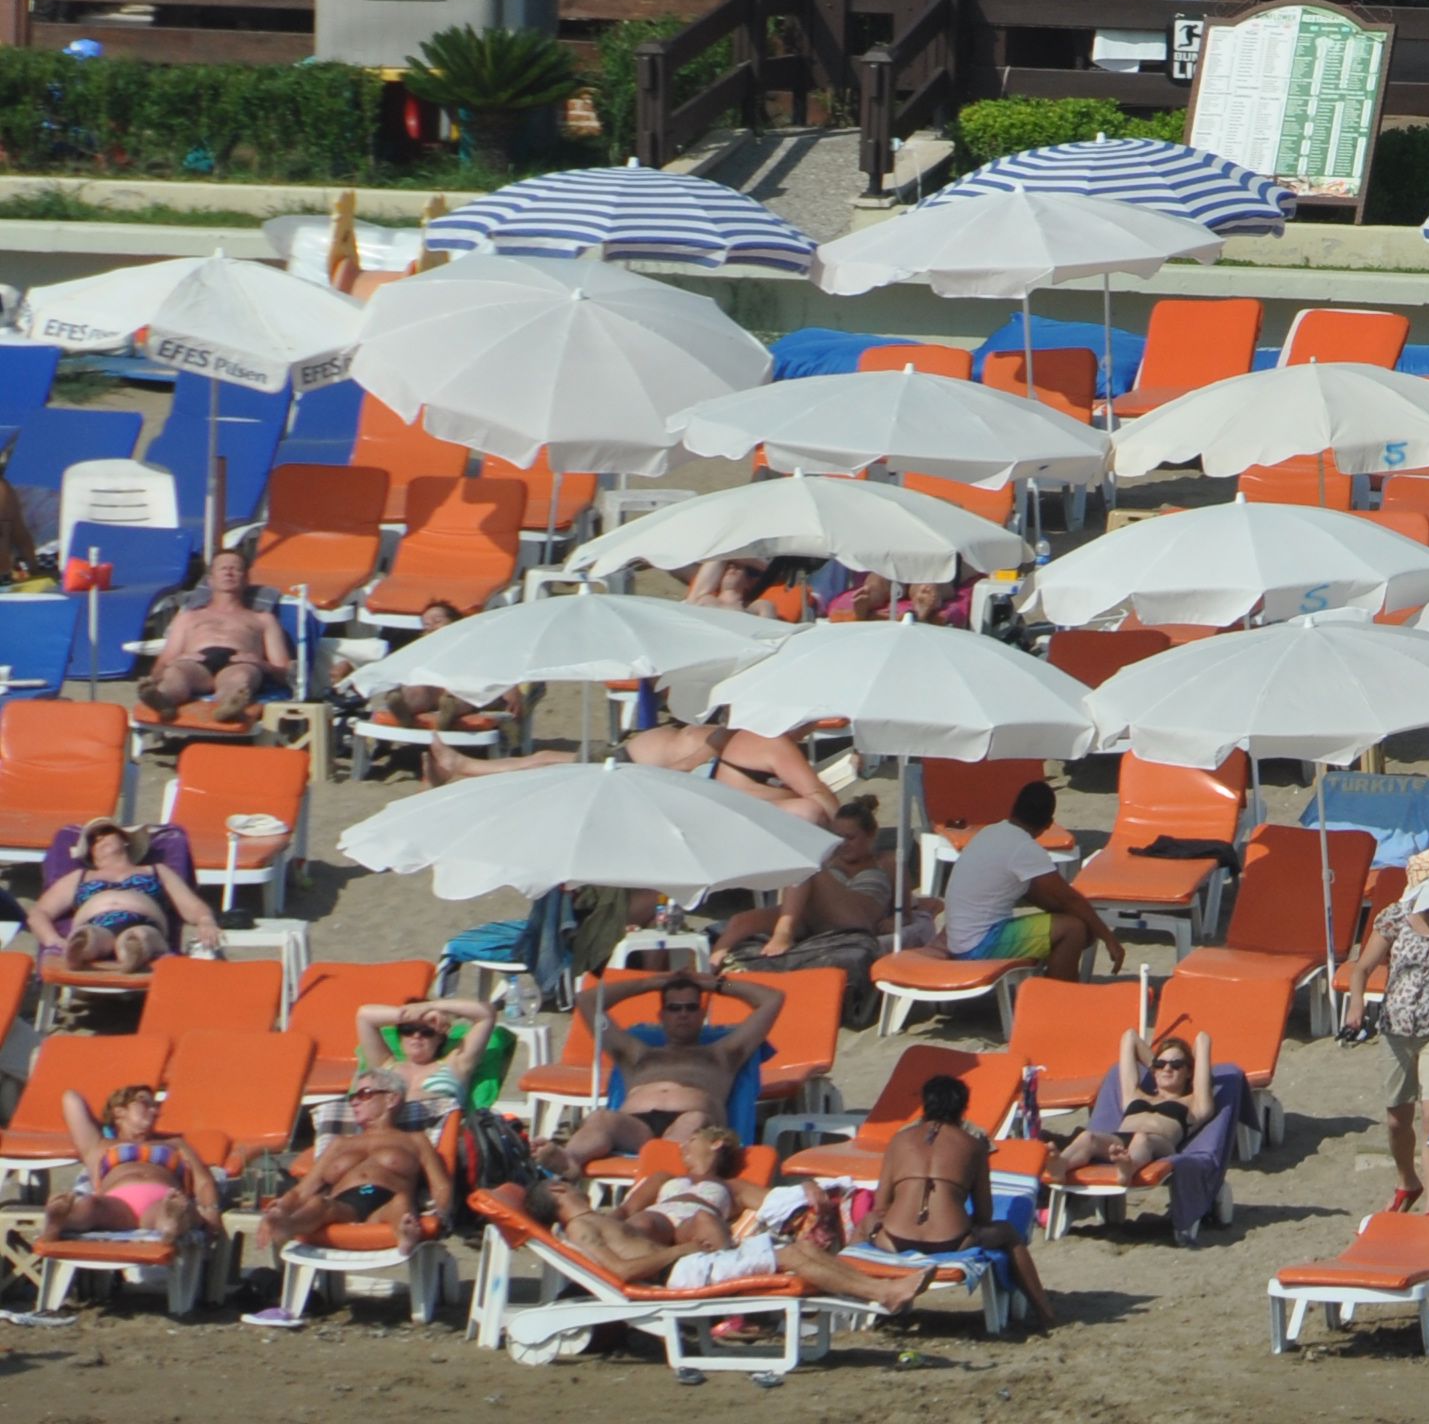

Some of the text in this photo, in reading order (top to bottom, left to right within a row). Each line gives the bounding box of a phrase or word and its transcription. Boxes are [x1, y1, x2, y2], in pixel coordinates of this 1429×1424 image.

[1173, 52, 1198, 62] BUN
[1173, 62, 1196, 79] LI
[44, 319, 88, 341] EFES
[157, 339, 268, 385] EFES Pilsen
[301, 356, 342, 385] EFES
